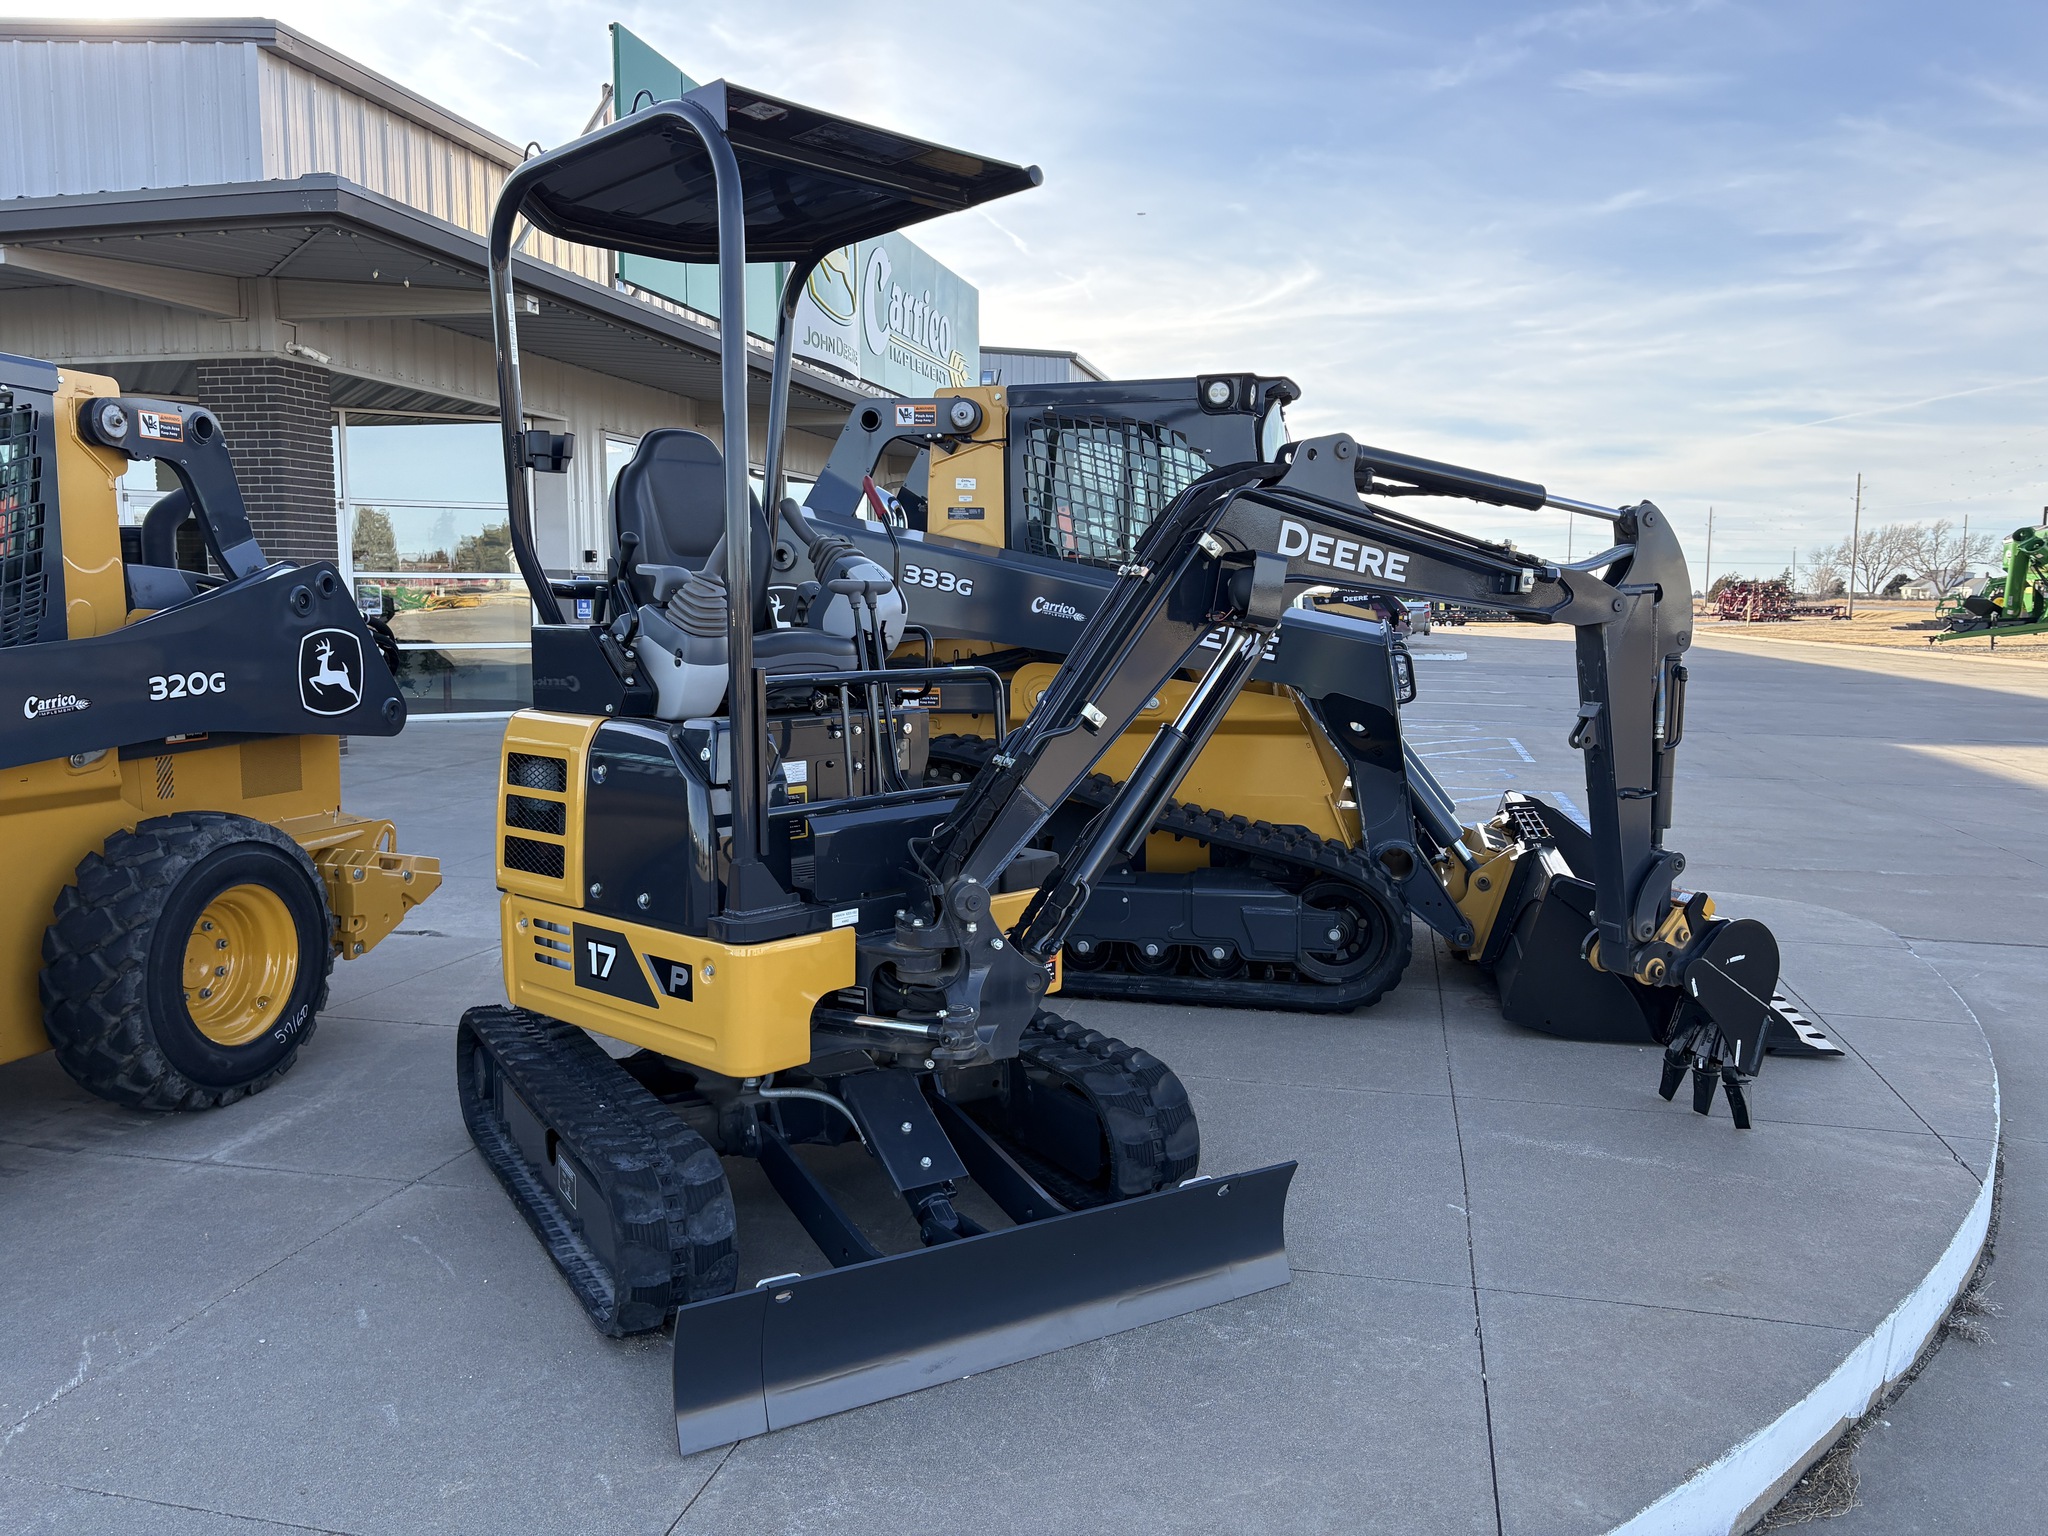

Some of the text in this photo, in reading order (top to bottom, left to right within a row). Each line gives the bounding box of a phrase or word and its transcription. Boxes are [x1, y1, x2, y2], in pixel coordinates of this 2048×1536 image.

[863, 247, 951, 358] Carrico
[803, 326, 835, 354] JOHN
[889, 345, 948, 385] IMPLEMENT
[1277, 519, 1410, 583] DEERE
[903, 564, 973, 596] 333G
[1031, 596, 1076, 614] Carrico
[1342, 595, 1369, 603] DEERE
[1041, 611, 1074, 619] IMPLEMENT
[149, 671, 226, 700] 320G
[24, 694, 77, 719] Carrico
[38, 707, 75, 716] IMPLEMENT
[587, 941, 617, 979] 17
[669, 965, 689, 993] P
[274, 1004, 309, 1044] 57/60
